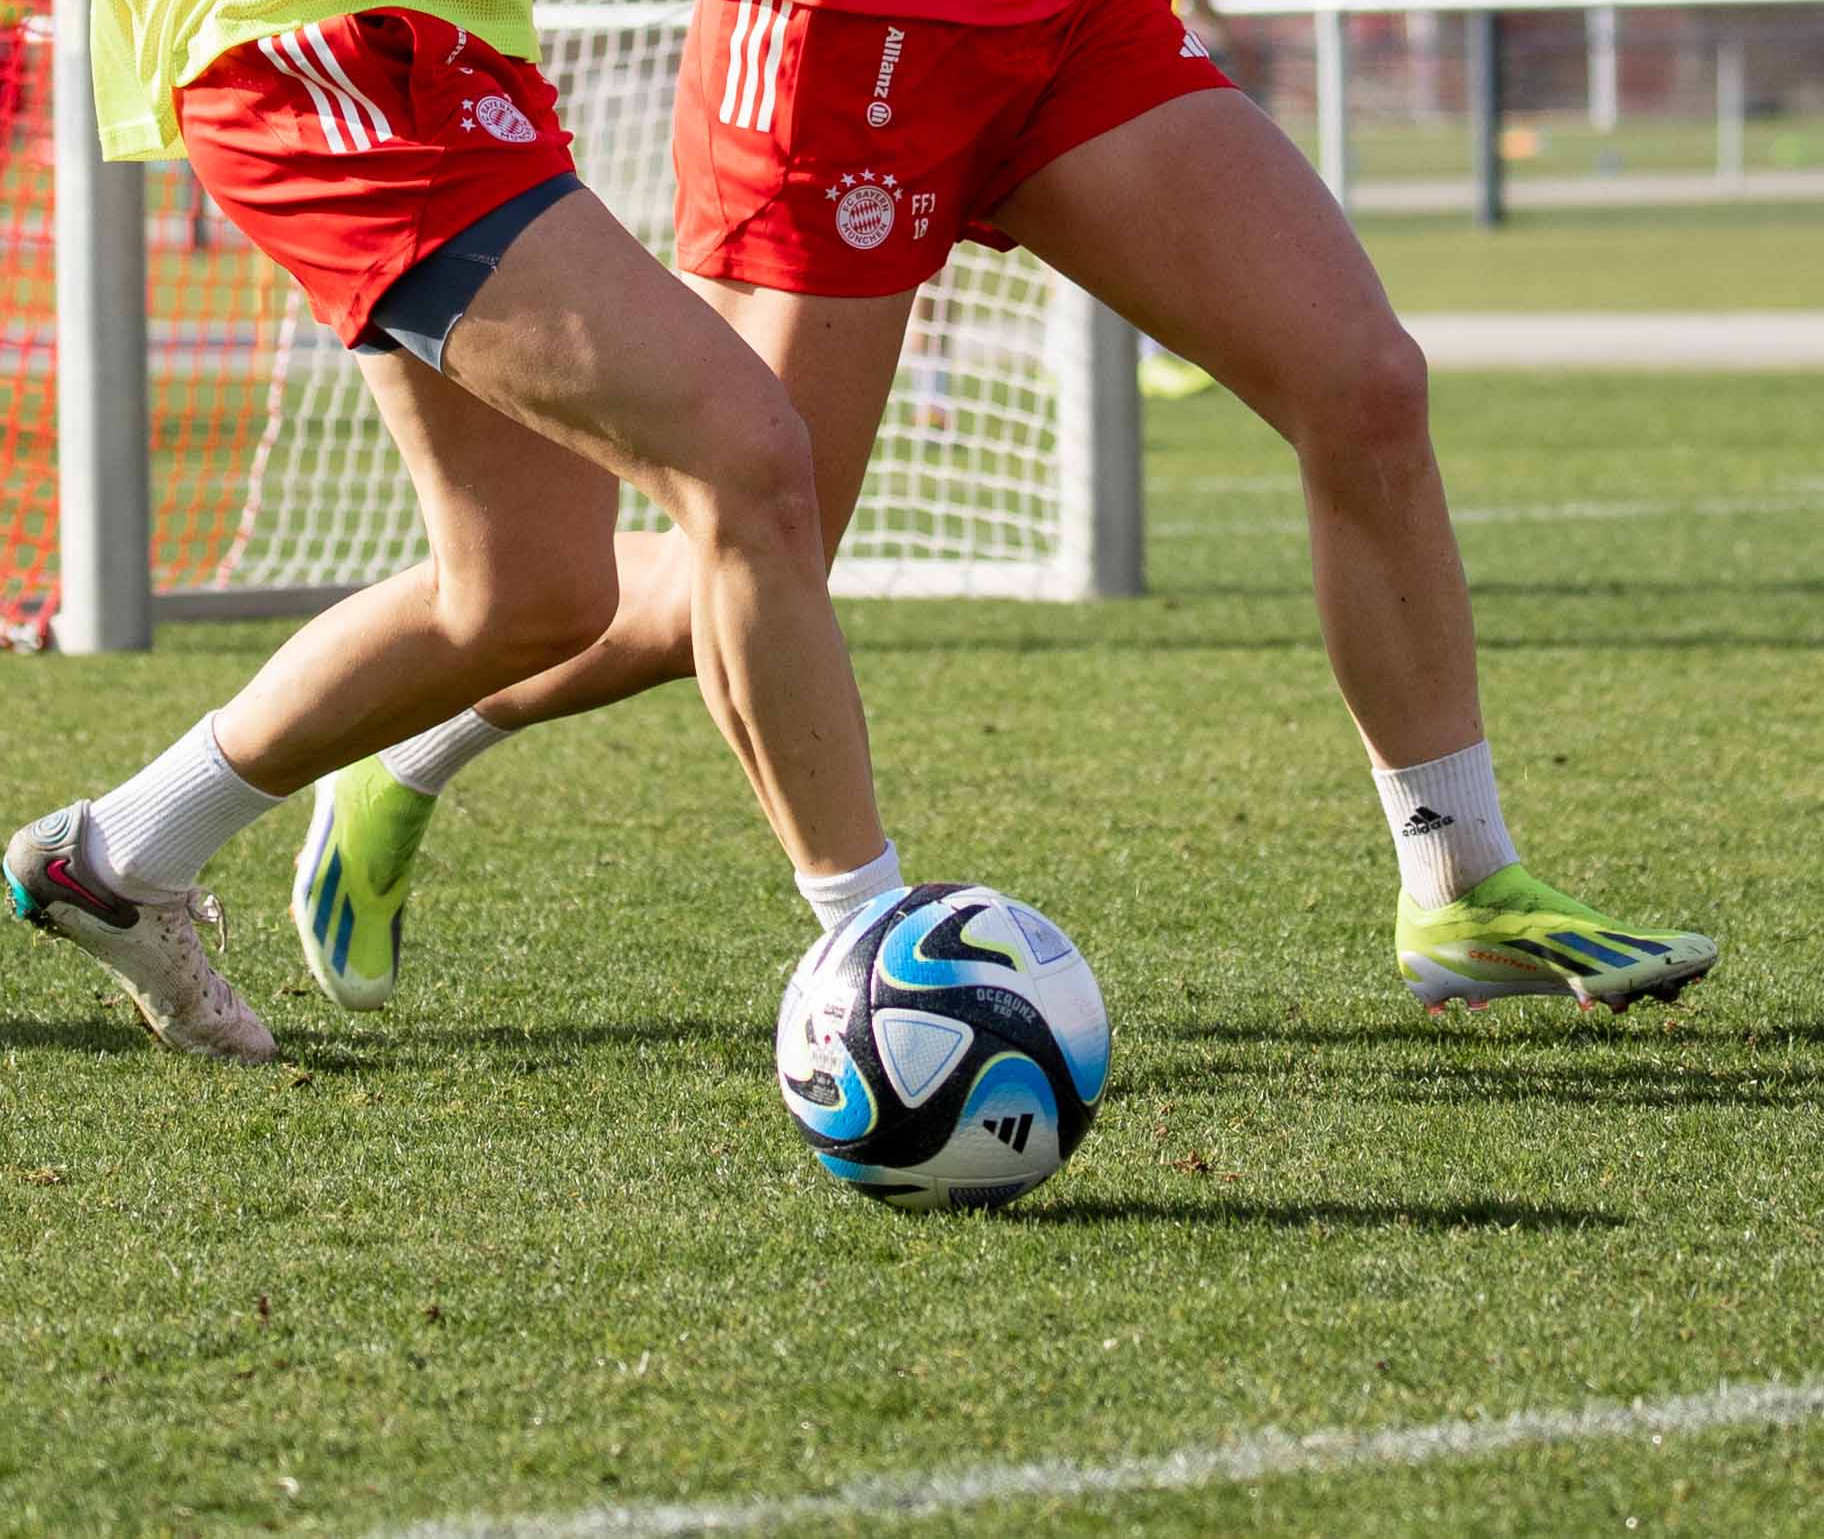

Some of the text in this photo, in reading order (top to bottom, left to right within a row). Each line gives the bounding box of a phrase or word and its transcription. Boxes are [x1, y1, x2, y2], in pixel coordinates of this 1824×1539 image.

[874, 26, 905, 99] Allianz
[842, 190, 890, 213] FC BAYERN
[913, 217, 929, 240] 18
[1402, 815, 1456, 838] adidas
